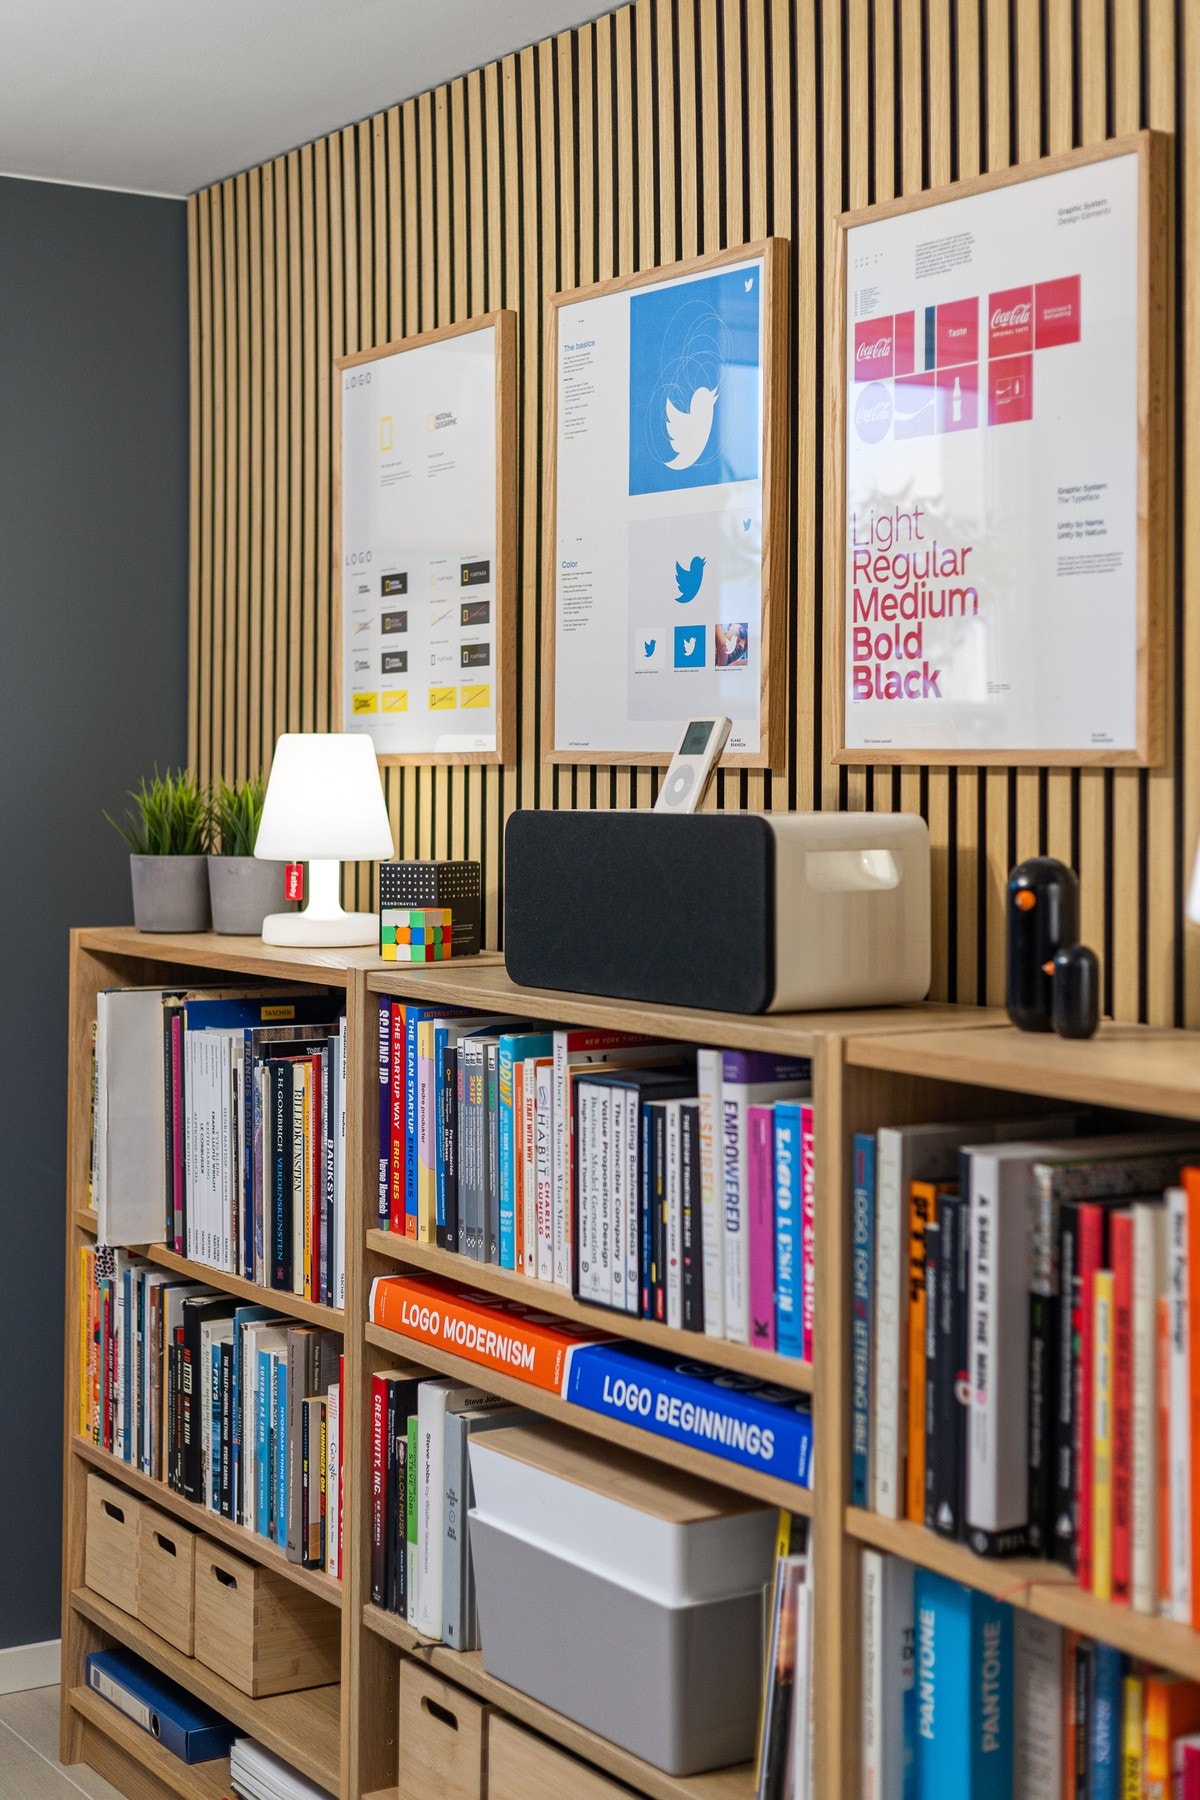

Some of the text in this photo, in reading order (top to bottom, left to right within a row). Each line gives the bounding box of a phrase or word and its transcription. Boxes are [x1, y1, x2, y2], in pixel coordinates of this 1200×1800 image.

[1058, 198, 1108, 216] Graphic System
[1058, 207, 1111, 226] Design Elements
[948, 327, 967, 339] Taste
[990, 303, 1031, 329] Coca-Cola
[564, 339, 596, 352] The basics
[856, 337, 893, 362] Coca-Cola
[345, 372, 372, 390] LOGO
[1057, 482, 1108, 496] Graphic System
[853, 505, 925, 552] Light
[1057, 520, 1074, 531] Unity
[1075, 520, 1083, 530] by
[1057, 530, 1074, 540] Unity
[1075, 530, 1083, 539] by
[346, 551, 372, 566] LOGO
[562, 560, 578, 569] Color
[853, 540, 973, 590] Regular
[852, 581, 979, 623] Medium
[852, 621, 923, 662] Bold
[852, 661, 943, 700] Black
[289, 871, 298, 898] fatboy
[265, 1009, 292, 1017] TASCHEN
[244, 1040, 252, 1146] FRANCIS BACON
[500, 1049, 512, 1108] SPRINT
[293, 1089, 302, 1192] BILLEDKUNSTEN
[538, 1113, 546, 1175] HABIT
[700, 1093, 714, 1203] INSPIRED
[379, 1158, 388, 1181] Verne
[591, 1096, 599, 1264] Business Model Generation
[601, 1141, 609, 1218] Proposition
[724, 1101, 740, 1233] EMPOWERED
[379, 1184, 388, 1214] Harnish
[601, 1222, 609, 1268] Design
[976, 1216, 988, 1274] SMILE
[976, 1283, 988, 1303] IN
[402, 1301, 536, 1371] LOGO MODERNISM
[854, 1188, 867, 1455] LOGO FONT LETTERING BIBLE
[976, 1311, 988, 1344] THE
[184, 1347, 190, 1362] NO
[554, 1349, 562, 1385] TASCHEN
[464, 1398, 483, 1406] Steve
[603, 1375, 775, 1460] LOGO BEGINNINGS
[374, 1394, 382, 1468] CREATIVITY,
[329, 1442, 338, 1481] Google
[320, 1477, 326, 1493] OM
[425, 1486, 430, 1498] by
[919, 1608, 935, 1739] PANTONE
[981, 1620, 1001, 1752] PANTONE
